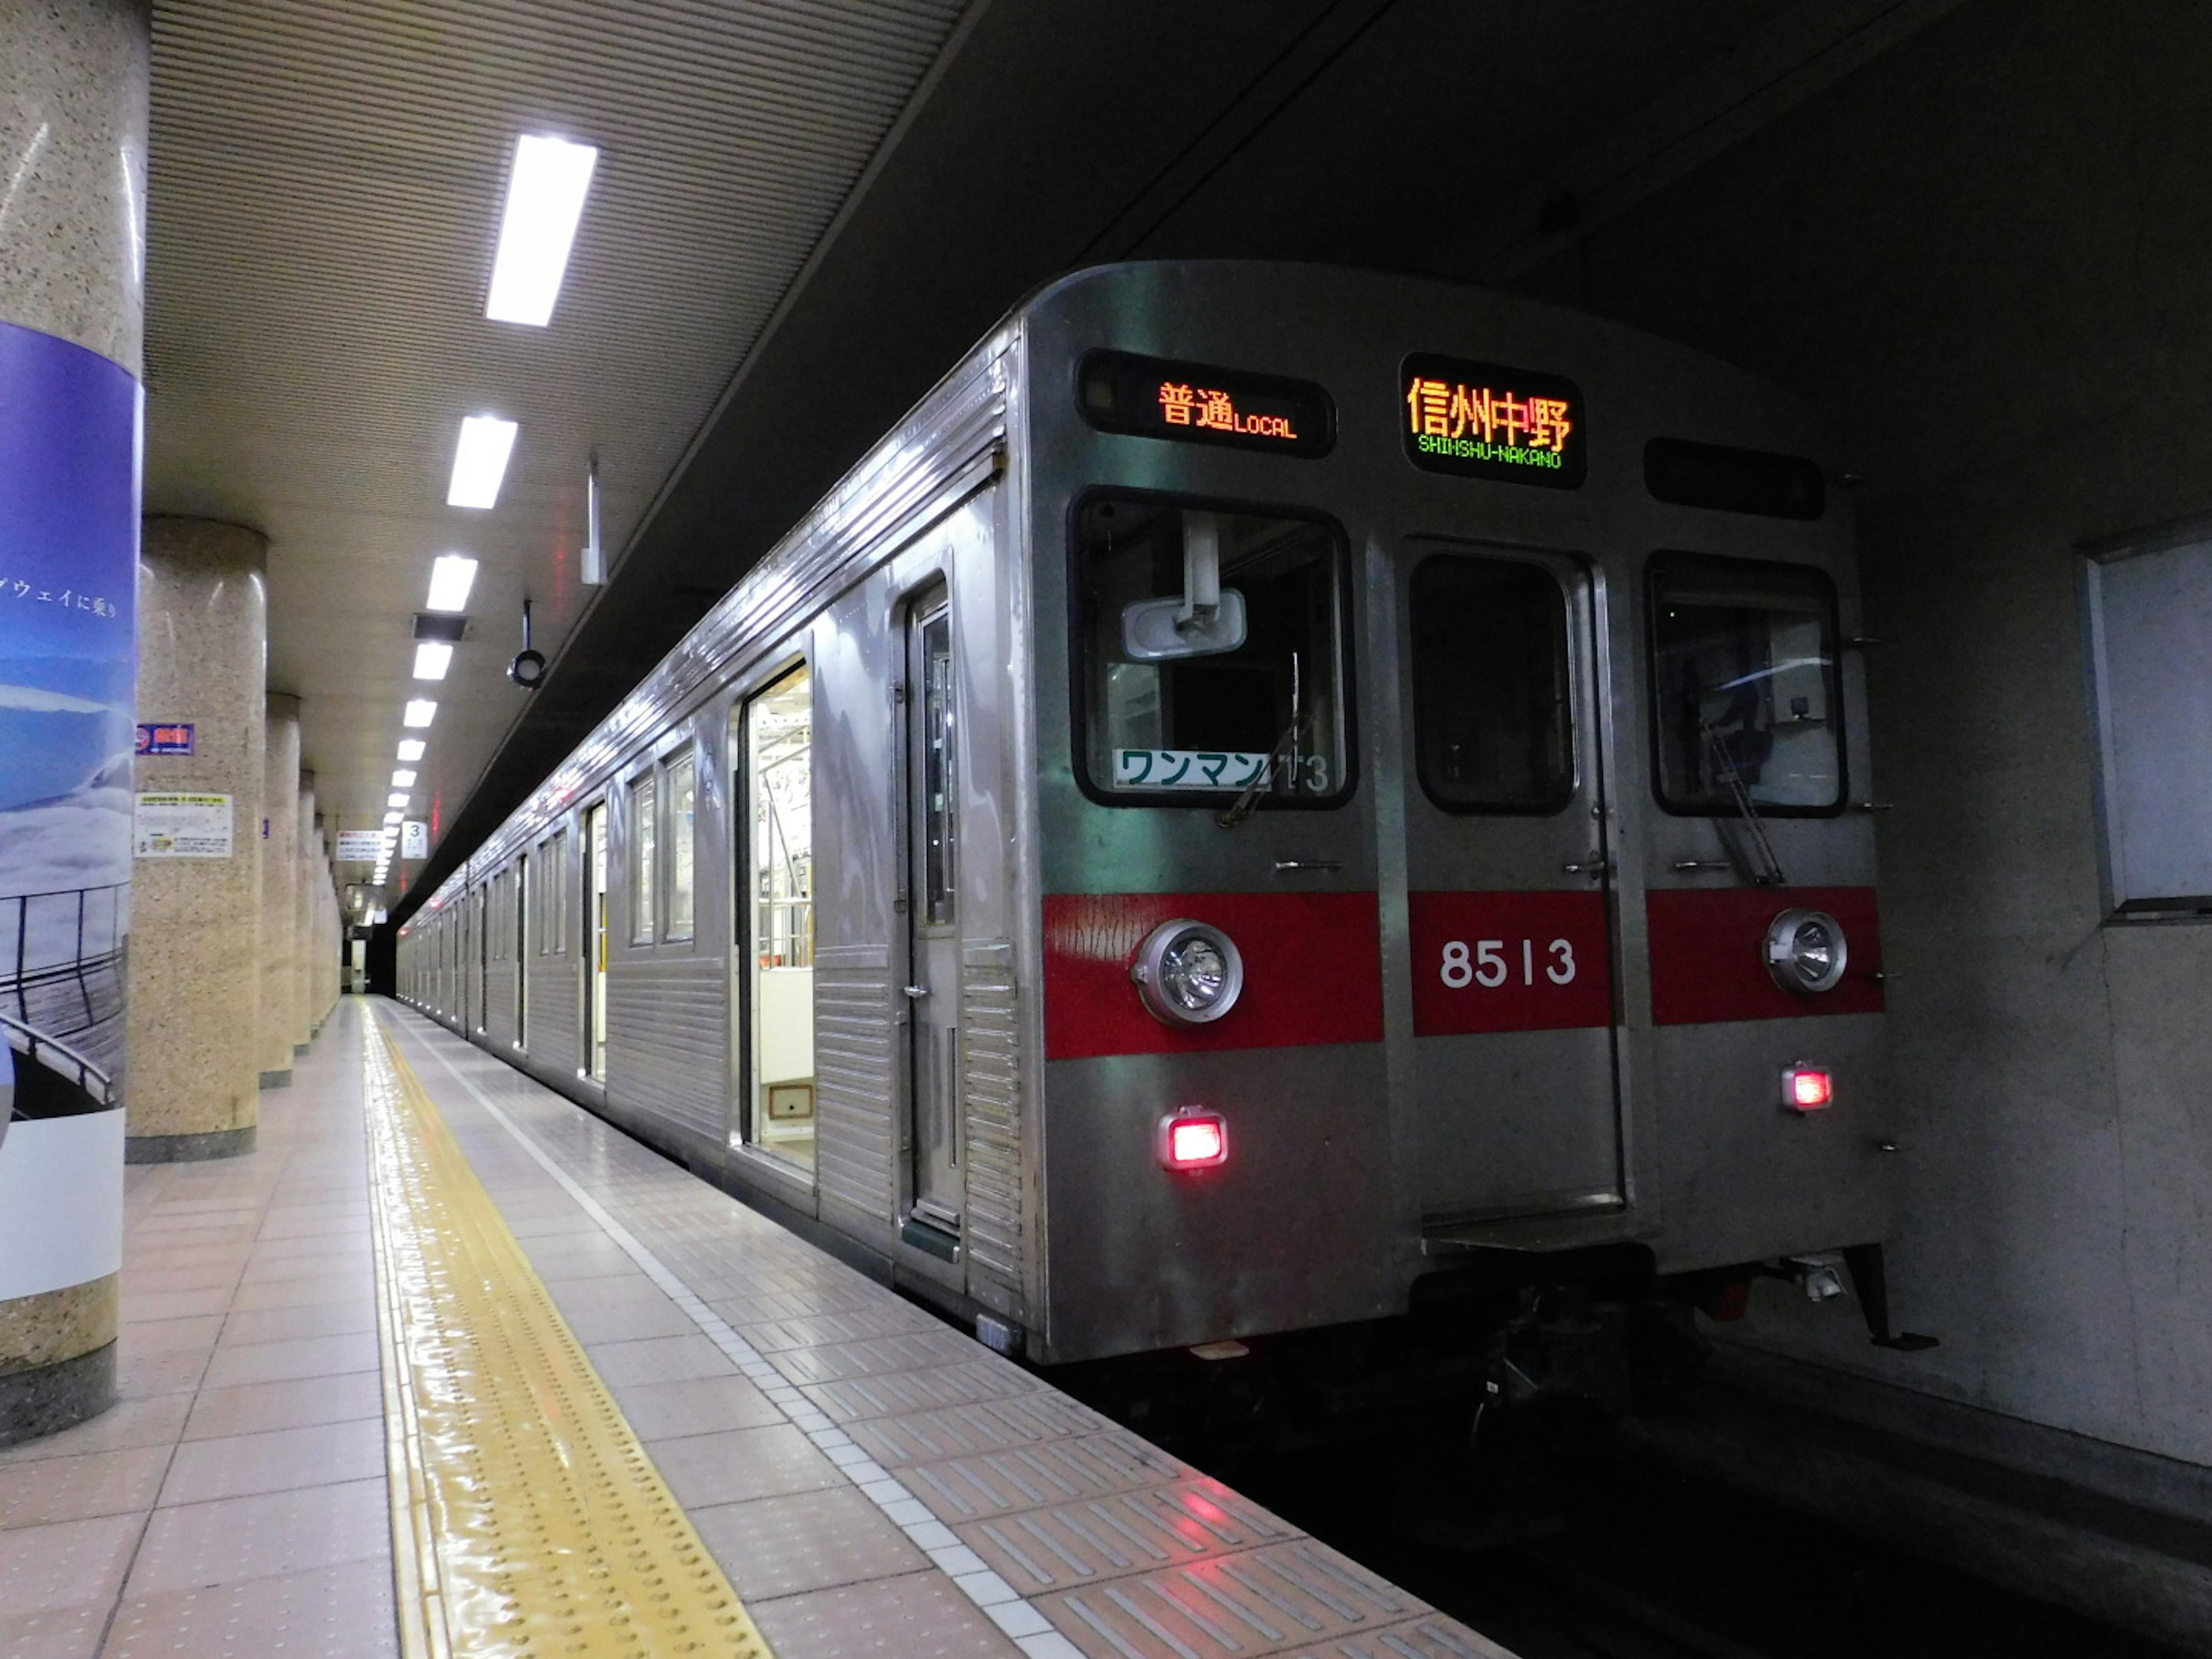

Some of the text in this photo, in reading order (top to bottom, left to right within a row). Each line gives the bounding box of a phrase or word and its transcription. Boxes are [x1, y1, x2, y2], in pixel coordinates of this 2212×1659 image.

[1159, 381, 1233, 431] 普通
[1407, 377, 1571, 453] 信州中野
[1234, 412, 1297, 439] LOCAL
[1418, 434, 1562, 469] SHINSHU-NAKANO
[1123, 751, 1263, 786] ワンマン
[410, 824, 420, 837] 3
[1441, 938, 1576, 988] 8513
